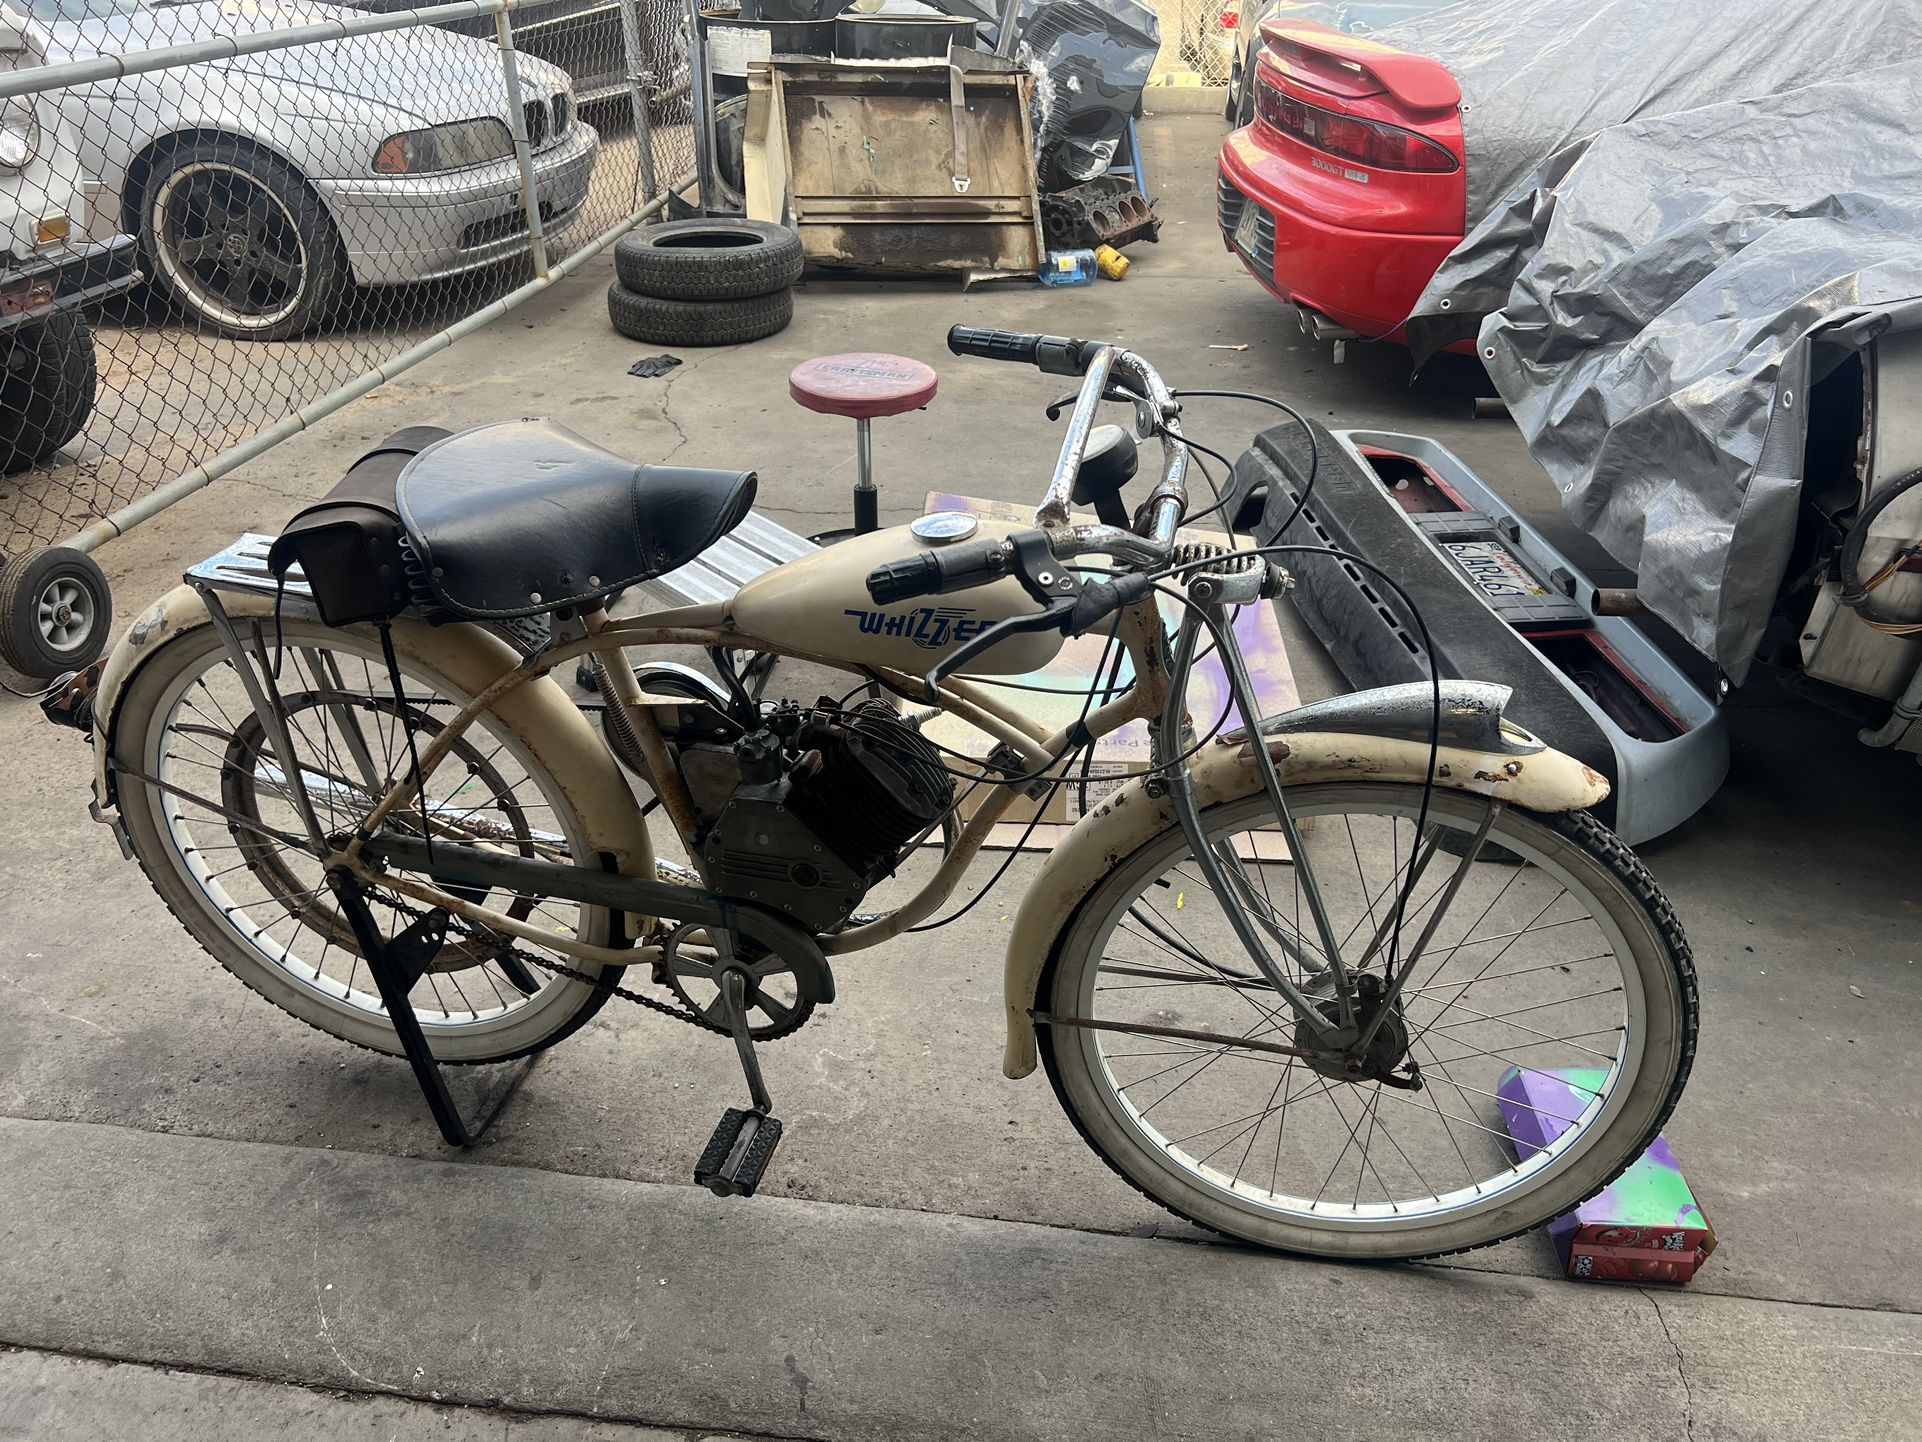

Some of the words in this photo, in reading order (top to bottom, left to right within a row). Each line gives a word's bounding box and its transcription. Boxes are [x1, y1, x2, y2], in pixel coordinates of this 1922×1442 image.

[1311, 157, 1344, 176] 3000GT
[820, 364, 909, 379] CRAFTSMAN
[1448, 544, 1525, 596] 6JAR461
